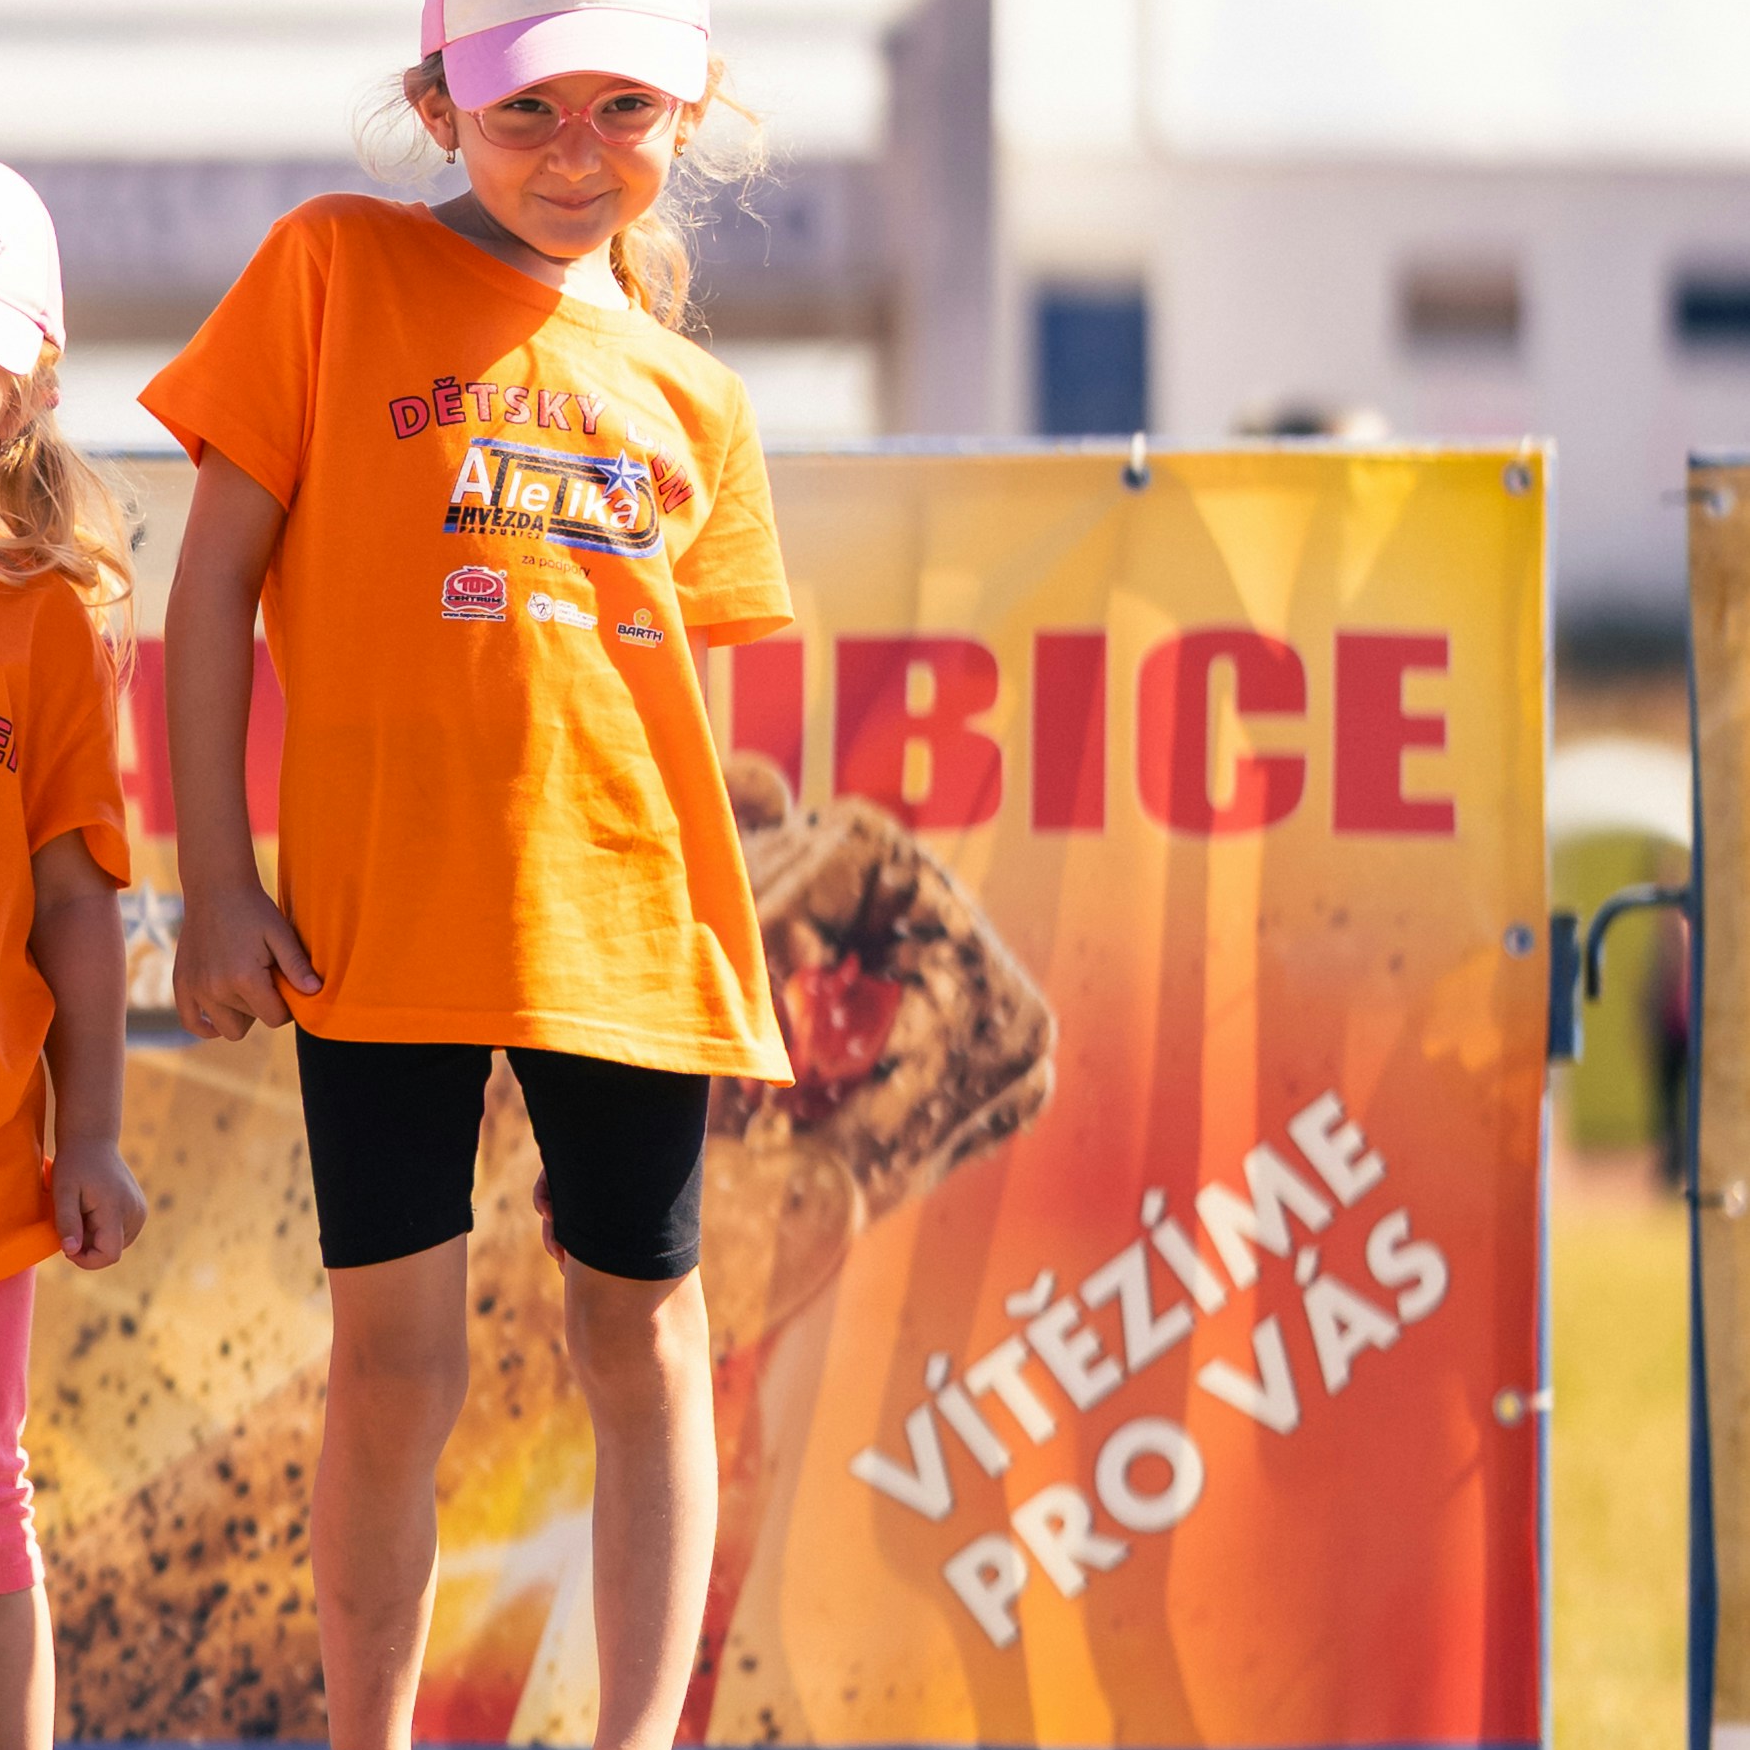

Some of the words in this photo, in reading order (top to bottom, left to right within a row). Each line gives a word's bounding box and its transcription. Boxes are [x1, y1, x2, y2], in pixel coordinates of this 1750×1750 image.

[389, 376, 608, 440] DĚTSKÝ
[539, 556, 591, 578] podpory
[447, 595, 501, 603] CENTRUM
[617, 624, 663, 641] BARTH
[849, 1088, 1387, 1523] VÍTĚZÍME
[942, 1415, 1206, 1650] PRO
[1195, 1207, 1450, 1436] VÁS
